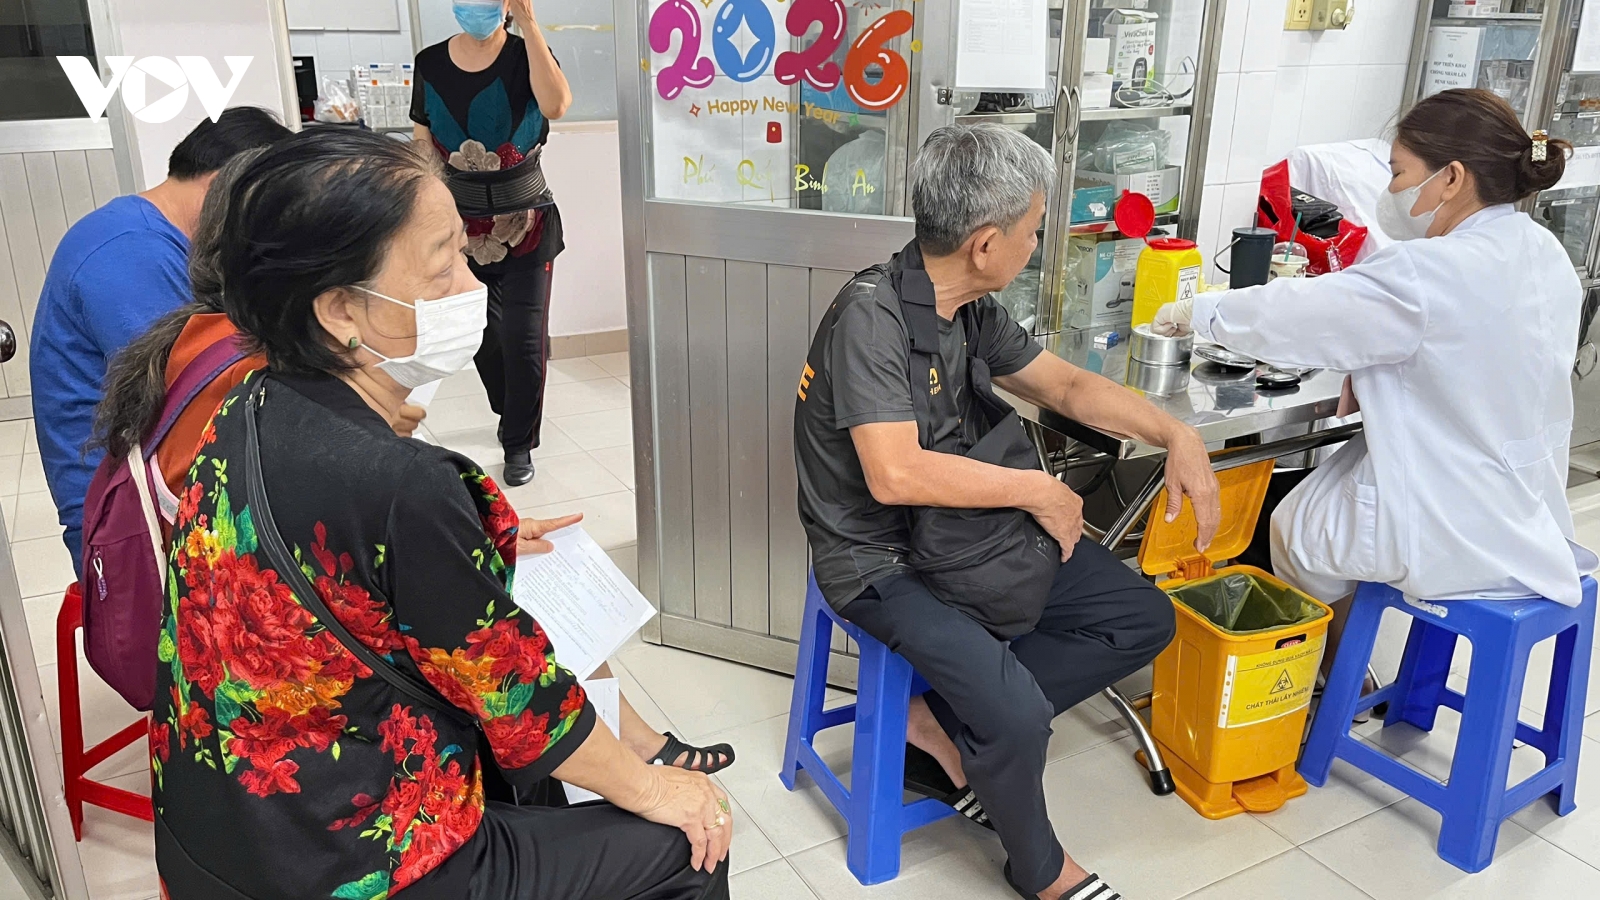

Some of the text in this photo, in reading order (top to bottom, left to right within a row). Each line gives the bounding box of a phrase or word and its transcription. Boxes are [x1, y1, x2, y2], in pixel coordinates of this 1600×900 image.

[649, 0, 914, 111] 2026
[707, 96, 841, 124] Happy New Year
[683, 154, 875, 203] Phú Quý Bình An
